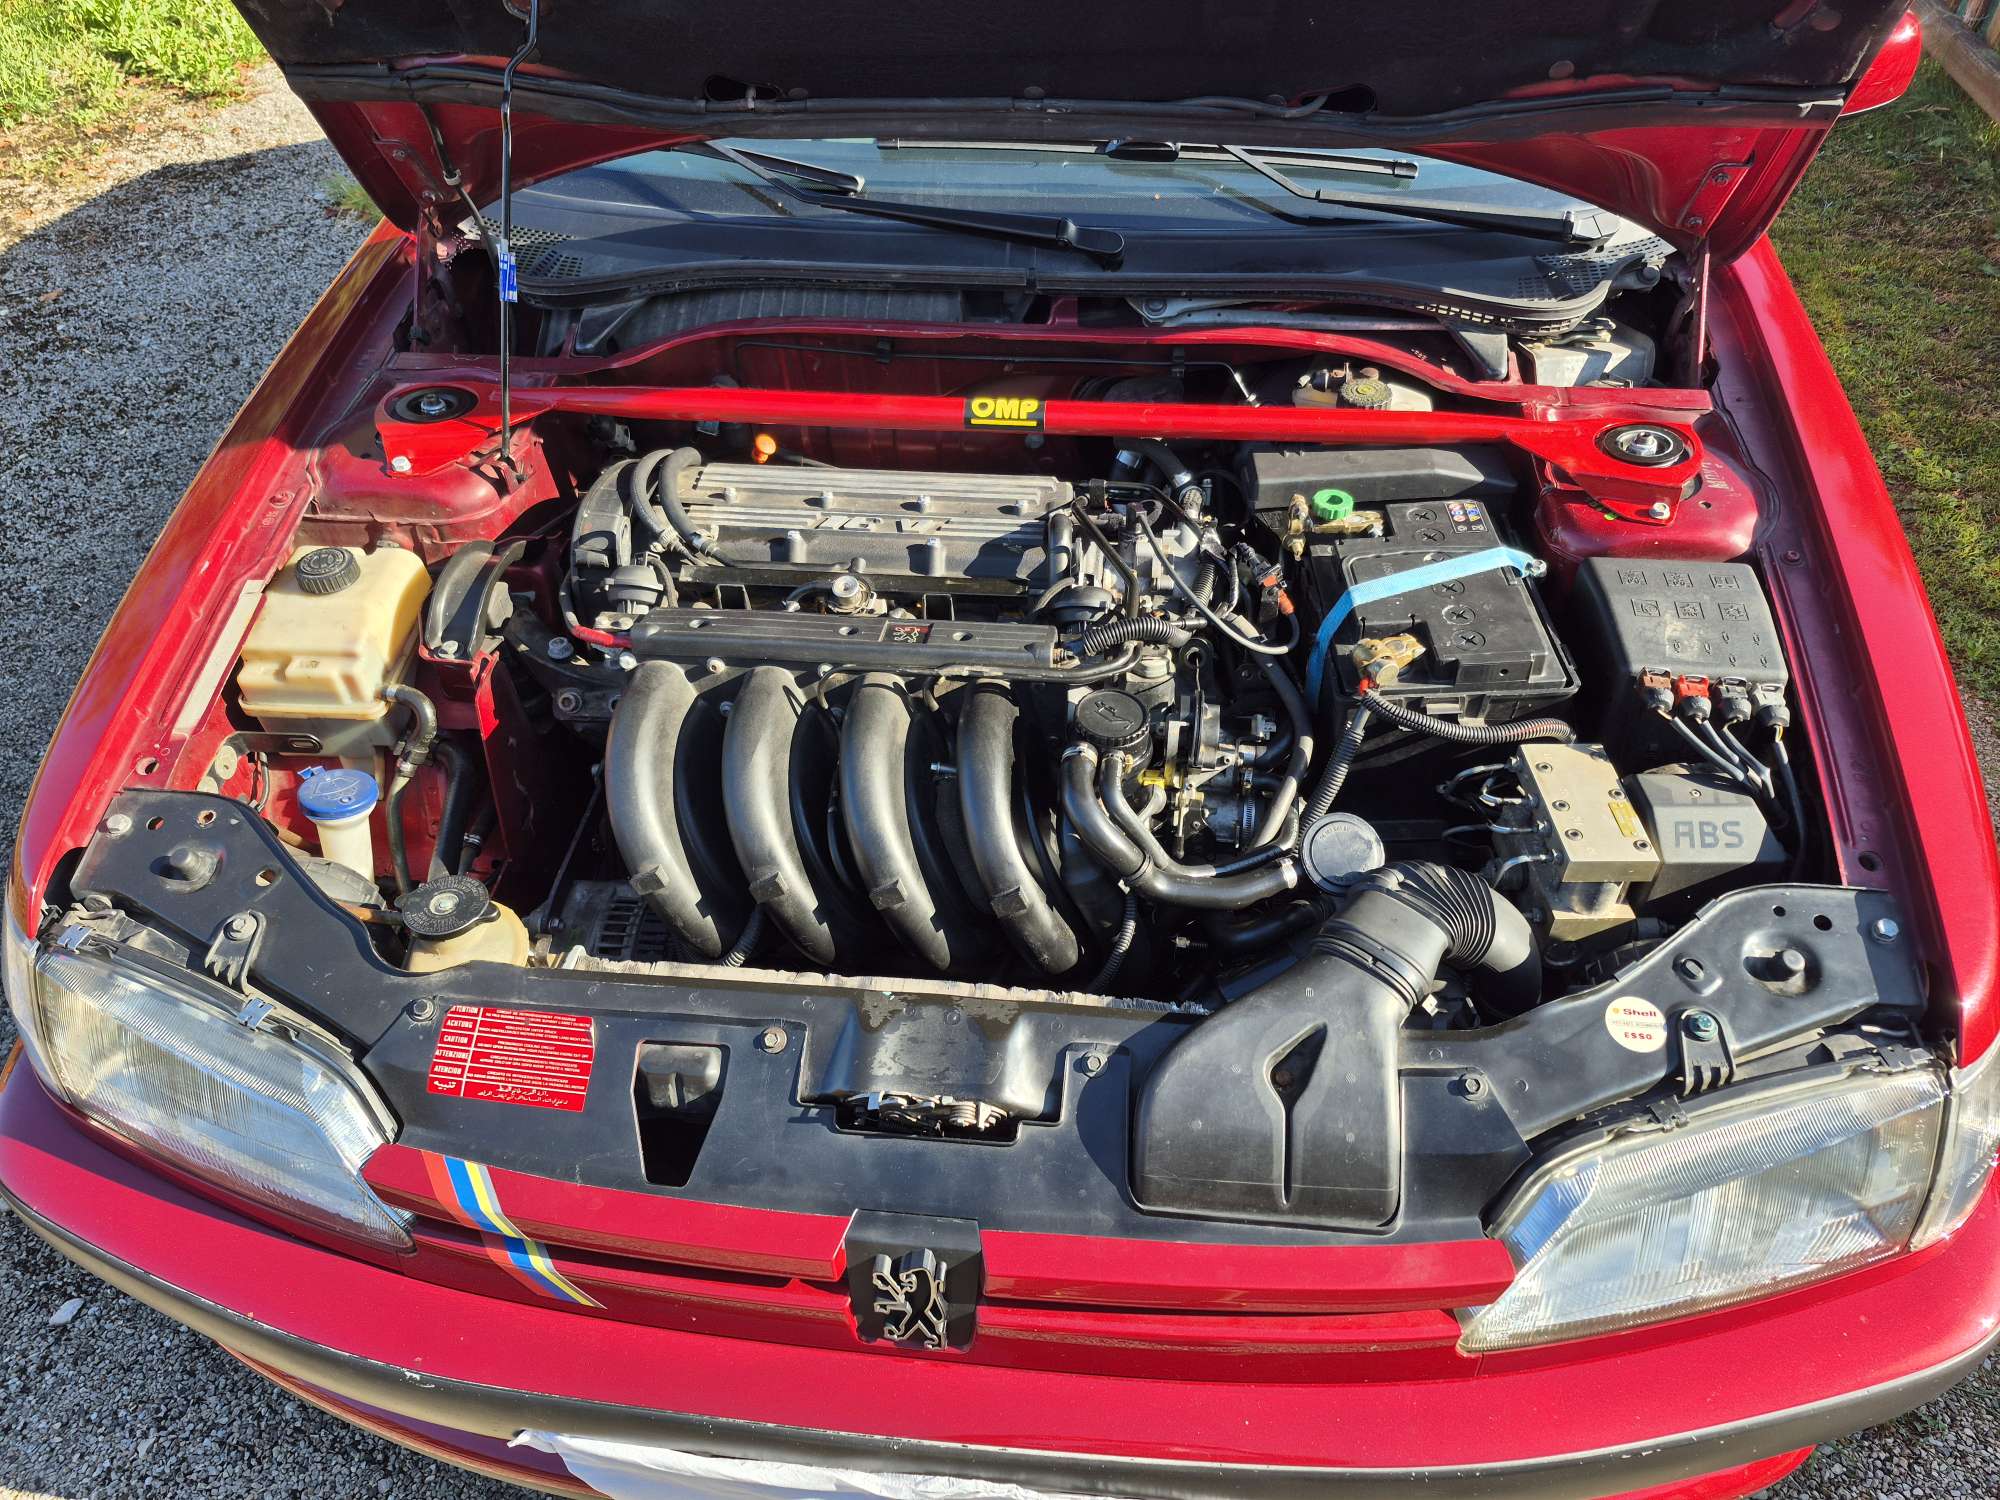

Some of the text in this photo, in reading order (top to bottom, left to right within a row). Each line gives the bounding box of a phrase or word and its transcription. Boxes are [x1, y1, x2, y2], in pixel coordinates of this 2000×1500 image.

[971, 397, 1039, 419] OMP
[1674, 820, 1744, 849] ABS
[1623, 1008, 1657, 1017] Shell
[446, 1019, 474, 1029] ACHTUNG
[443, 1034, 469, 1044] CAUTION
[435, 1049, 470, 1060] ATTENZIONE
